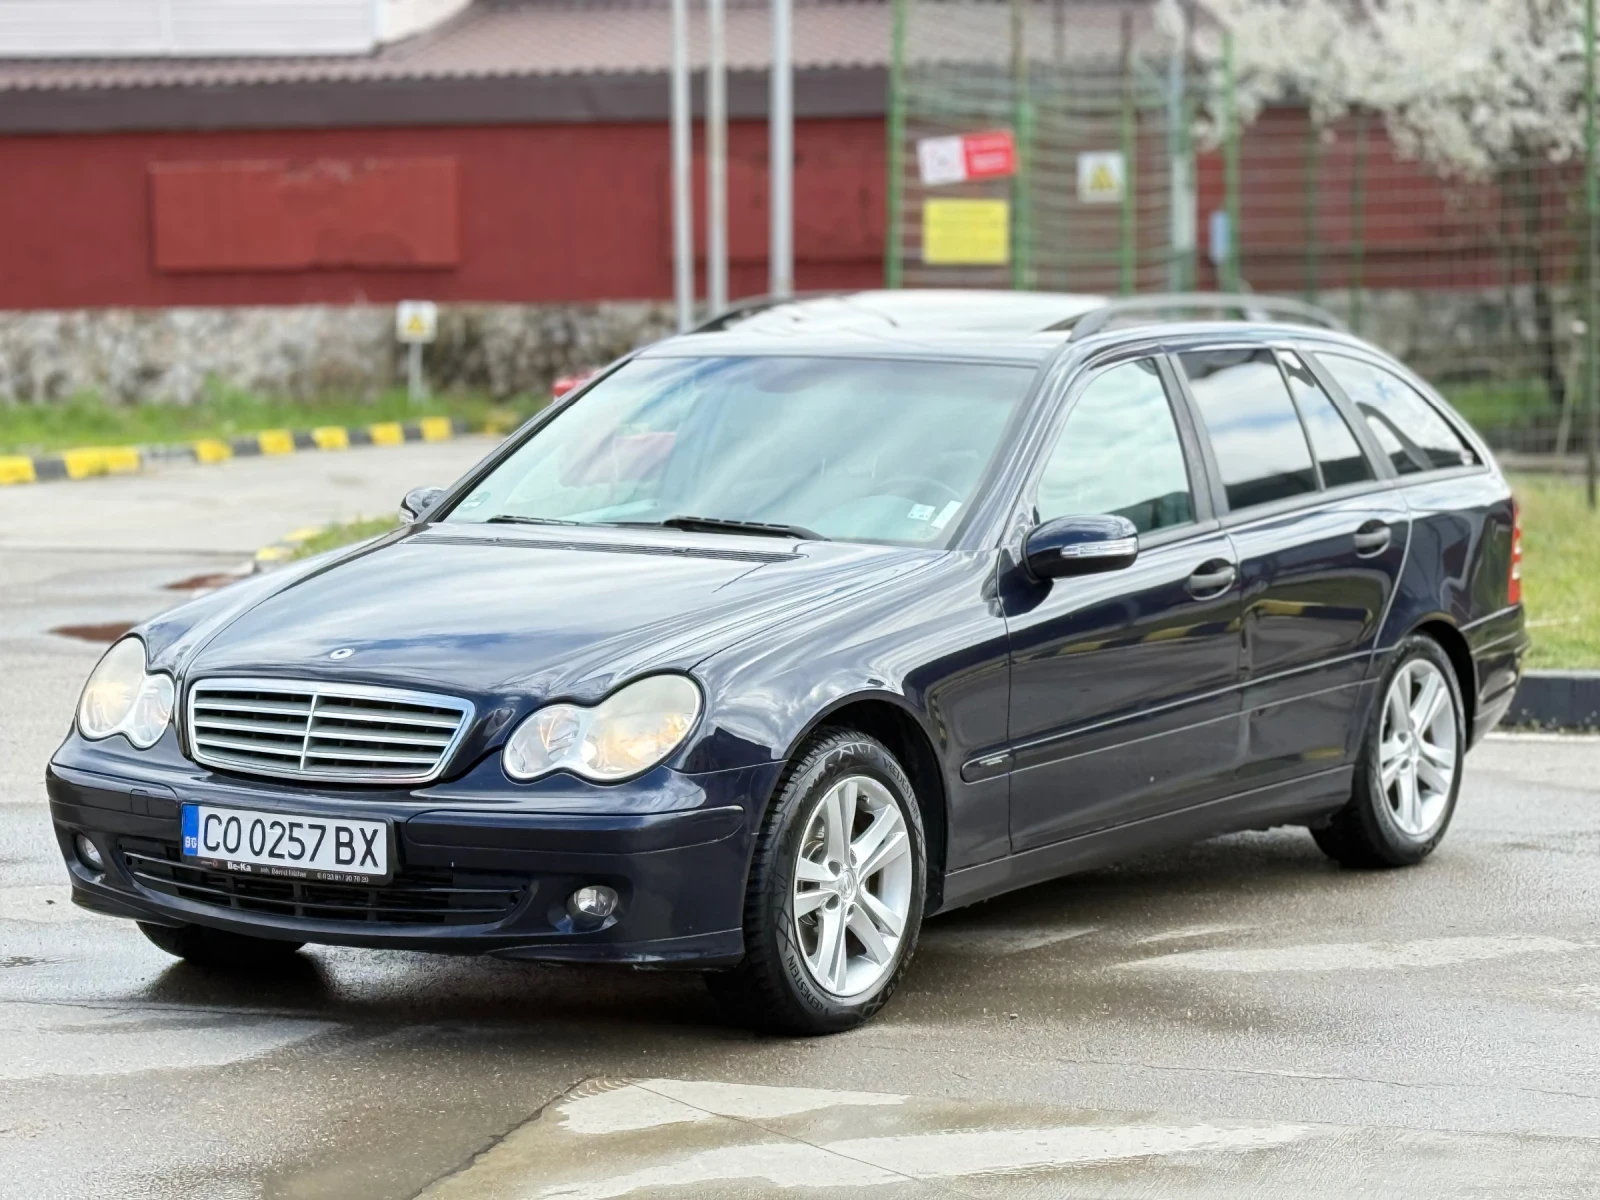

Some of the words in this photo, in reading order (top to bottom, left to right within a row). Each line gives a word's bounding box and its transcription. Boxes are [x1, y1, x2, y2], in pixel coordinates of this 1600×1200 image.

[184, 836, 198, 848] BG
[203, 813, 242, 854] CO
[249, 818, 327, 862] 0257
[334, 825, 380, 868] BX
[226, 860, 252, 872] Be-Ka
[787, 955, 829, 1016] VREDESTEIN
